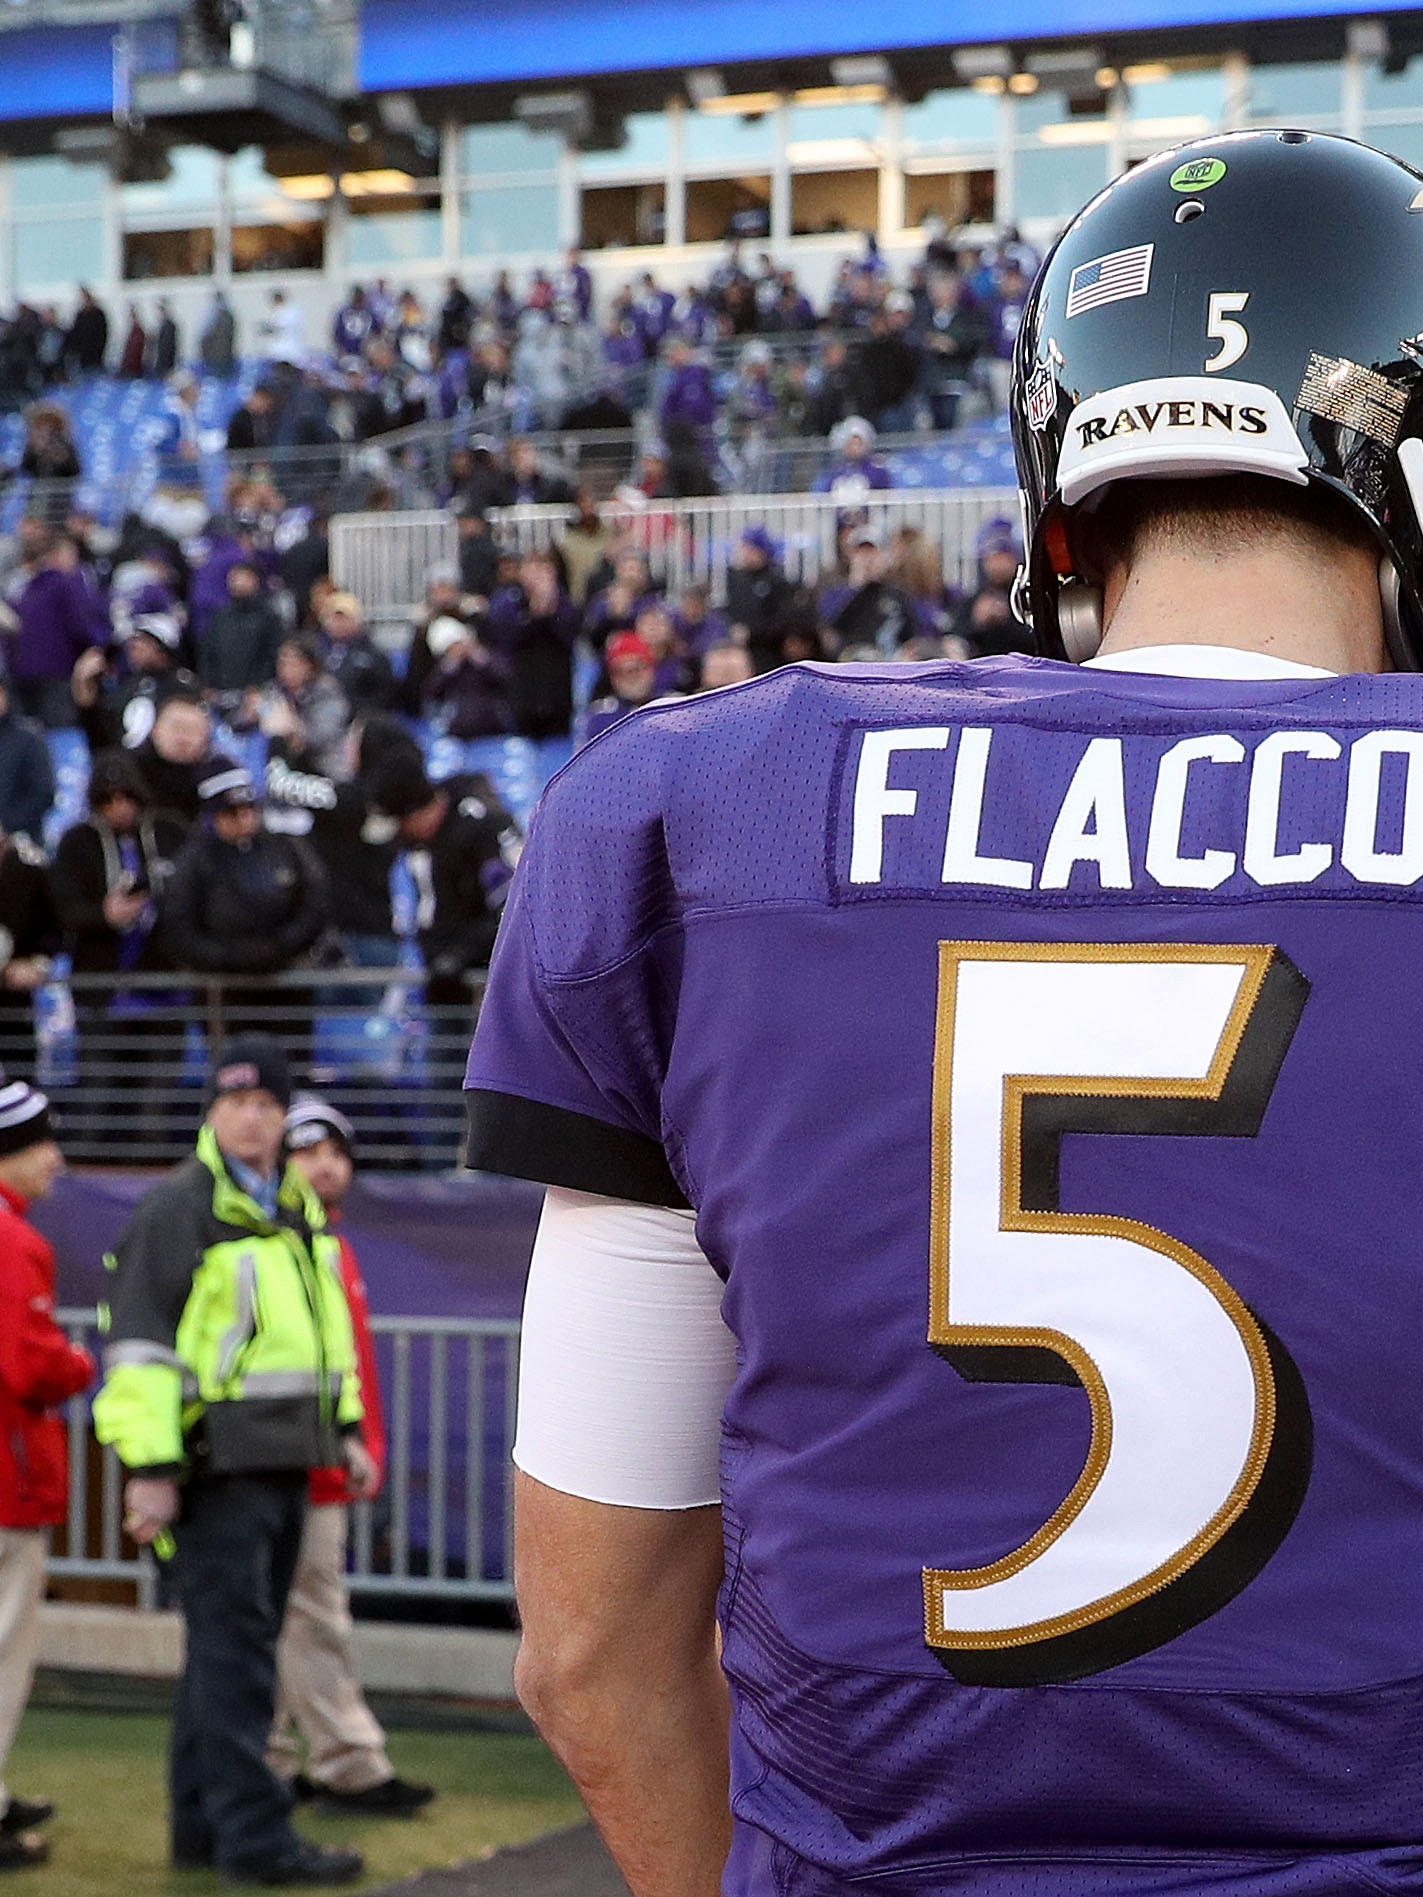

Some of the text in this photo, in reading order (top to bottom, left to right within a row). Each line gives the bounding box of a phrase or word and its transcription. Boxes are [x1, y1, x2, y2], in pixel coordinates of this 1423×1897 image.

[1204, 292, 1250, 373] 5
[1030, 386, 1053, 421] NFL
[1076, 401, 1268, 449] RAVENS
[922, 940, 1314, 1688] 5
